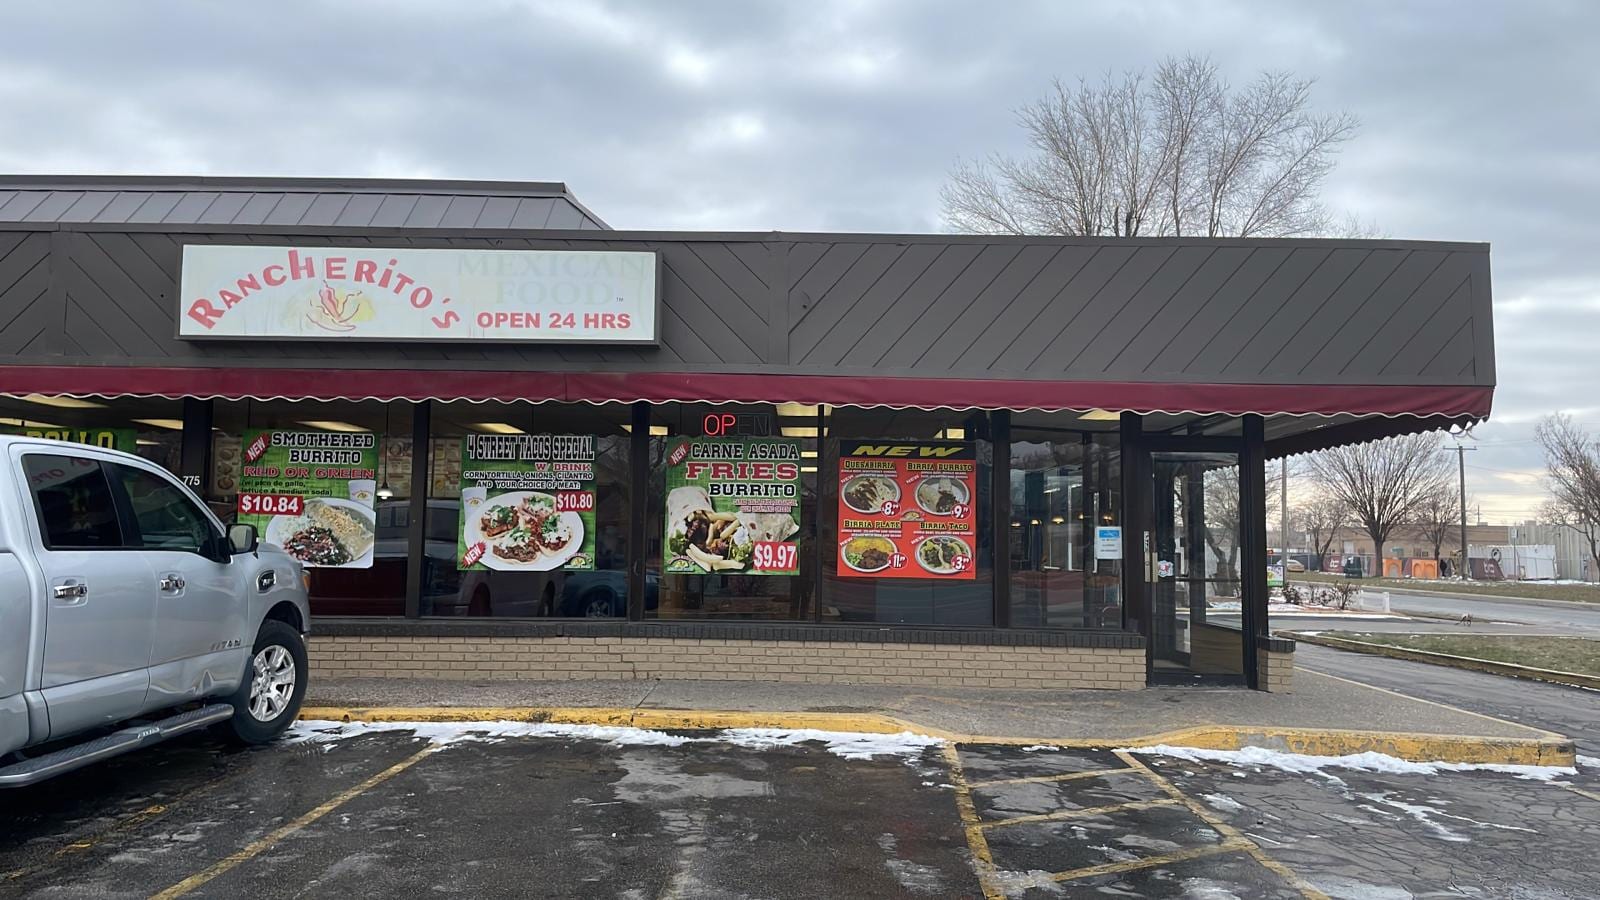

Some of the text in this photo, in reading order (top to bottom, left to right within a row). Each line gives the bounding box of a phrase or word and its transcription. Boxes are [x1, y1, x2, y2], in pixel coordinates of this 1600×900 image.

[458, 254, 648, 280] MEXICAN
[496, 281, 614, 305] FOOD
[477, 312, 632, 330] OPEN 24 HRS
[272, 432, 375, 448] SMOTHERED
[467, 435, 594, 460] 4 STREET TACOS SPECIAL
[247, 437, 266, 461] NEW
[289, 449, 362, 465] BURRITO
[670, 445, 687, 465] NEW
[691, 443, 799, 460] CARNE ASADA
[852, 446, 964, 457] NEW
[243, 466, 375, 479] RED OR GREEN
[553, 462, 591, 471] DRINK
[686, 462, 798, 480] FRIES
[907, 463, 973, 472] BIRRIA BURRITO
[183, 475, 200, 486] 775
[464, 471, 485, 480] CORN
[486, 471, 524, 480] TORTILLA,
[557, 472, 593, 480] CILANTRO
[477, 480, 493, 488] AND
[495, 481, 517, 489] YOUR
[518, 481, 546, 489] CHOICE
[547, 481, 557, 489] OF
[709, 483, 796, 497] BURRITO
[241, 495, 299, 512] $10.84
[557, 494, 593, 509] $10.80
[844, 520, 872, 529] BIRRIA
[920, 522, 947, 530] BIRRIA
[464, 545, 482, 565] NEW
[754, 544, 797, 569] $9.97
